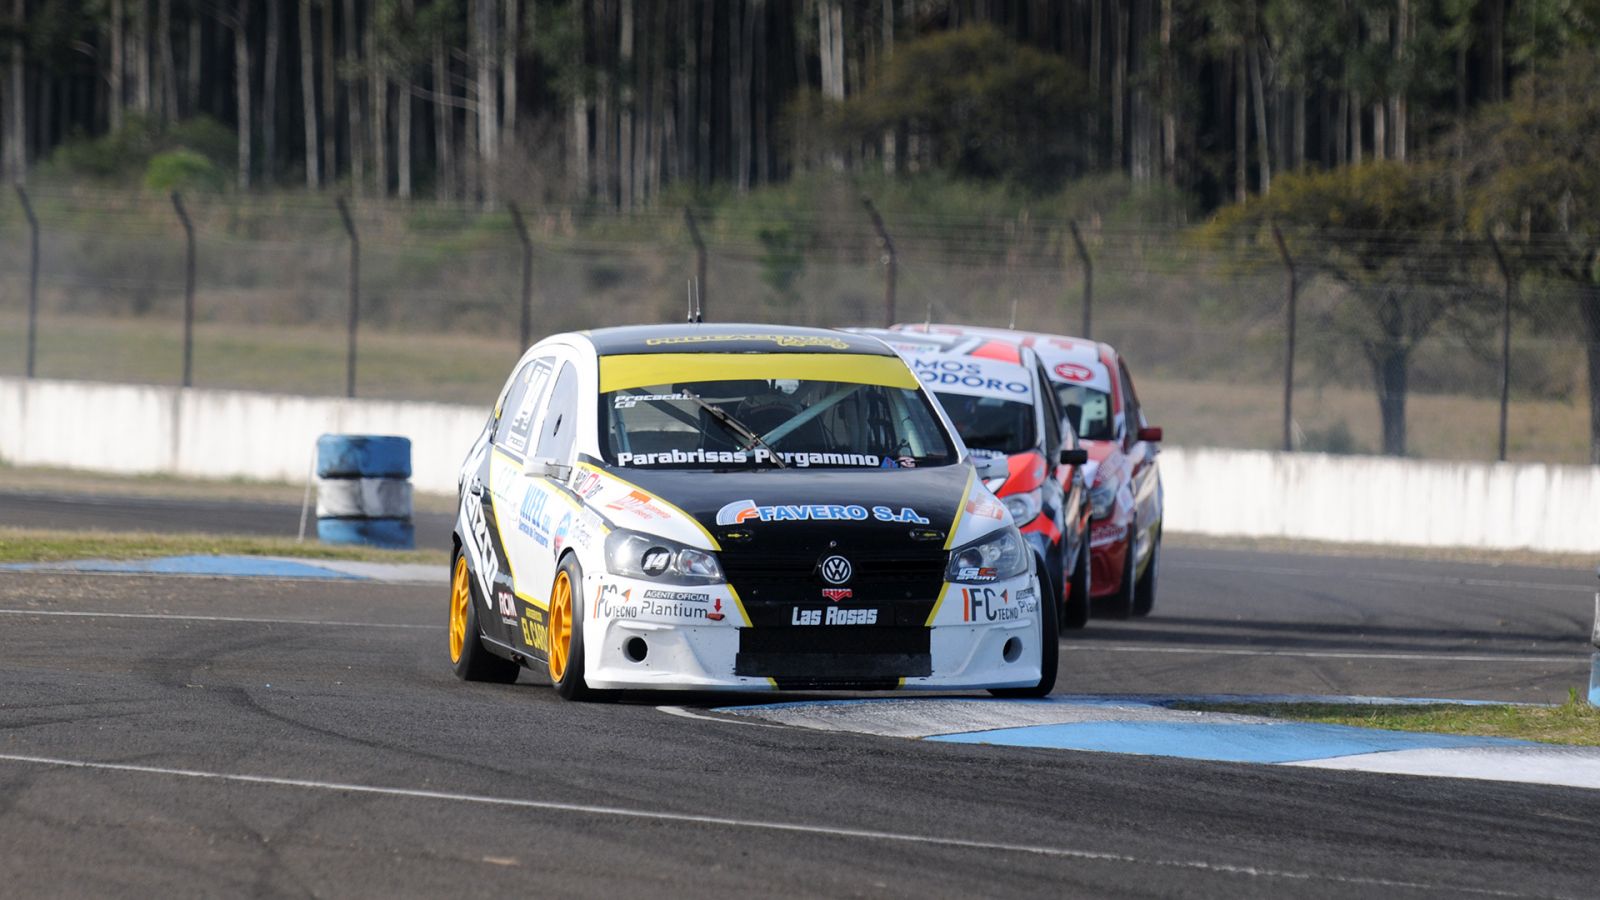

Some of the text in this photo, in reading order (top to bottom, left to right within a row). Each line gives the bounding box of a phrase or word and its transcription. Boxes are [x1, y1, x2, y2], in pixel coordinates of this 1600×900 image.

[617, 448, 748, 467] Parabrisas
[754, 449, 880, 467] Pergamino
[757, 504, 931, 525] FAVERO S.A.
[642, 552, 671, 571] 14
[644, 590, 708, 602] AGENTE OFICIAL
[961, 587, 998, 623] IFC
[997, 607, 1019, 621] TECNO
[612, 605, 637, 618] TECNO
[640, 600, 708, 619] Plantium
[791, 606, 878, 626] Las Rosas
